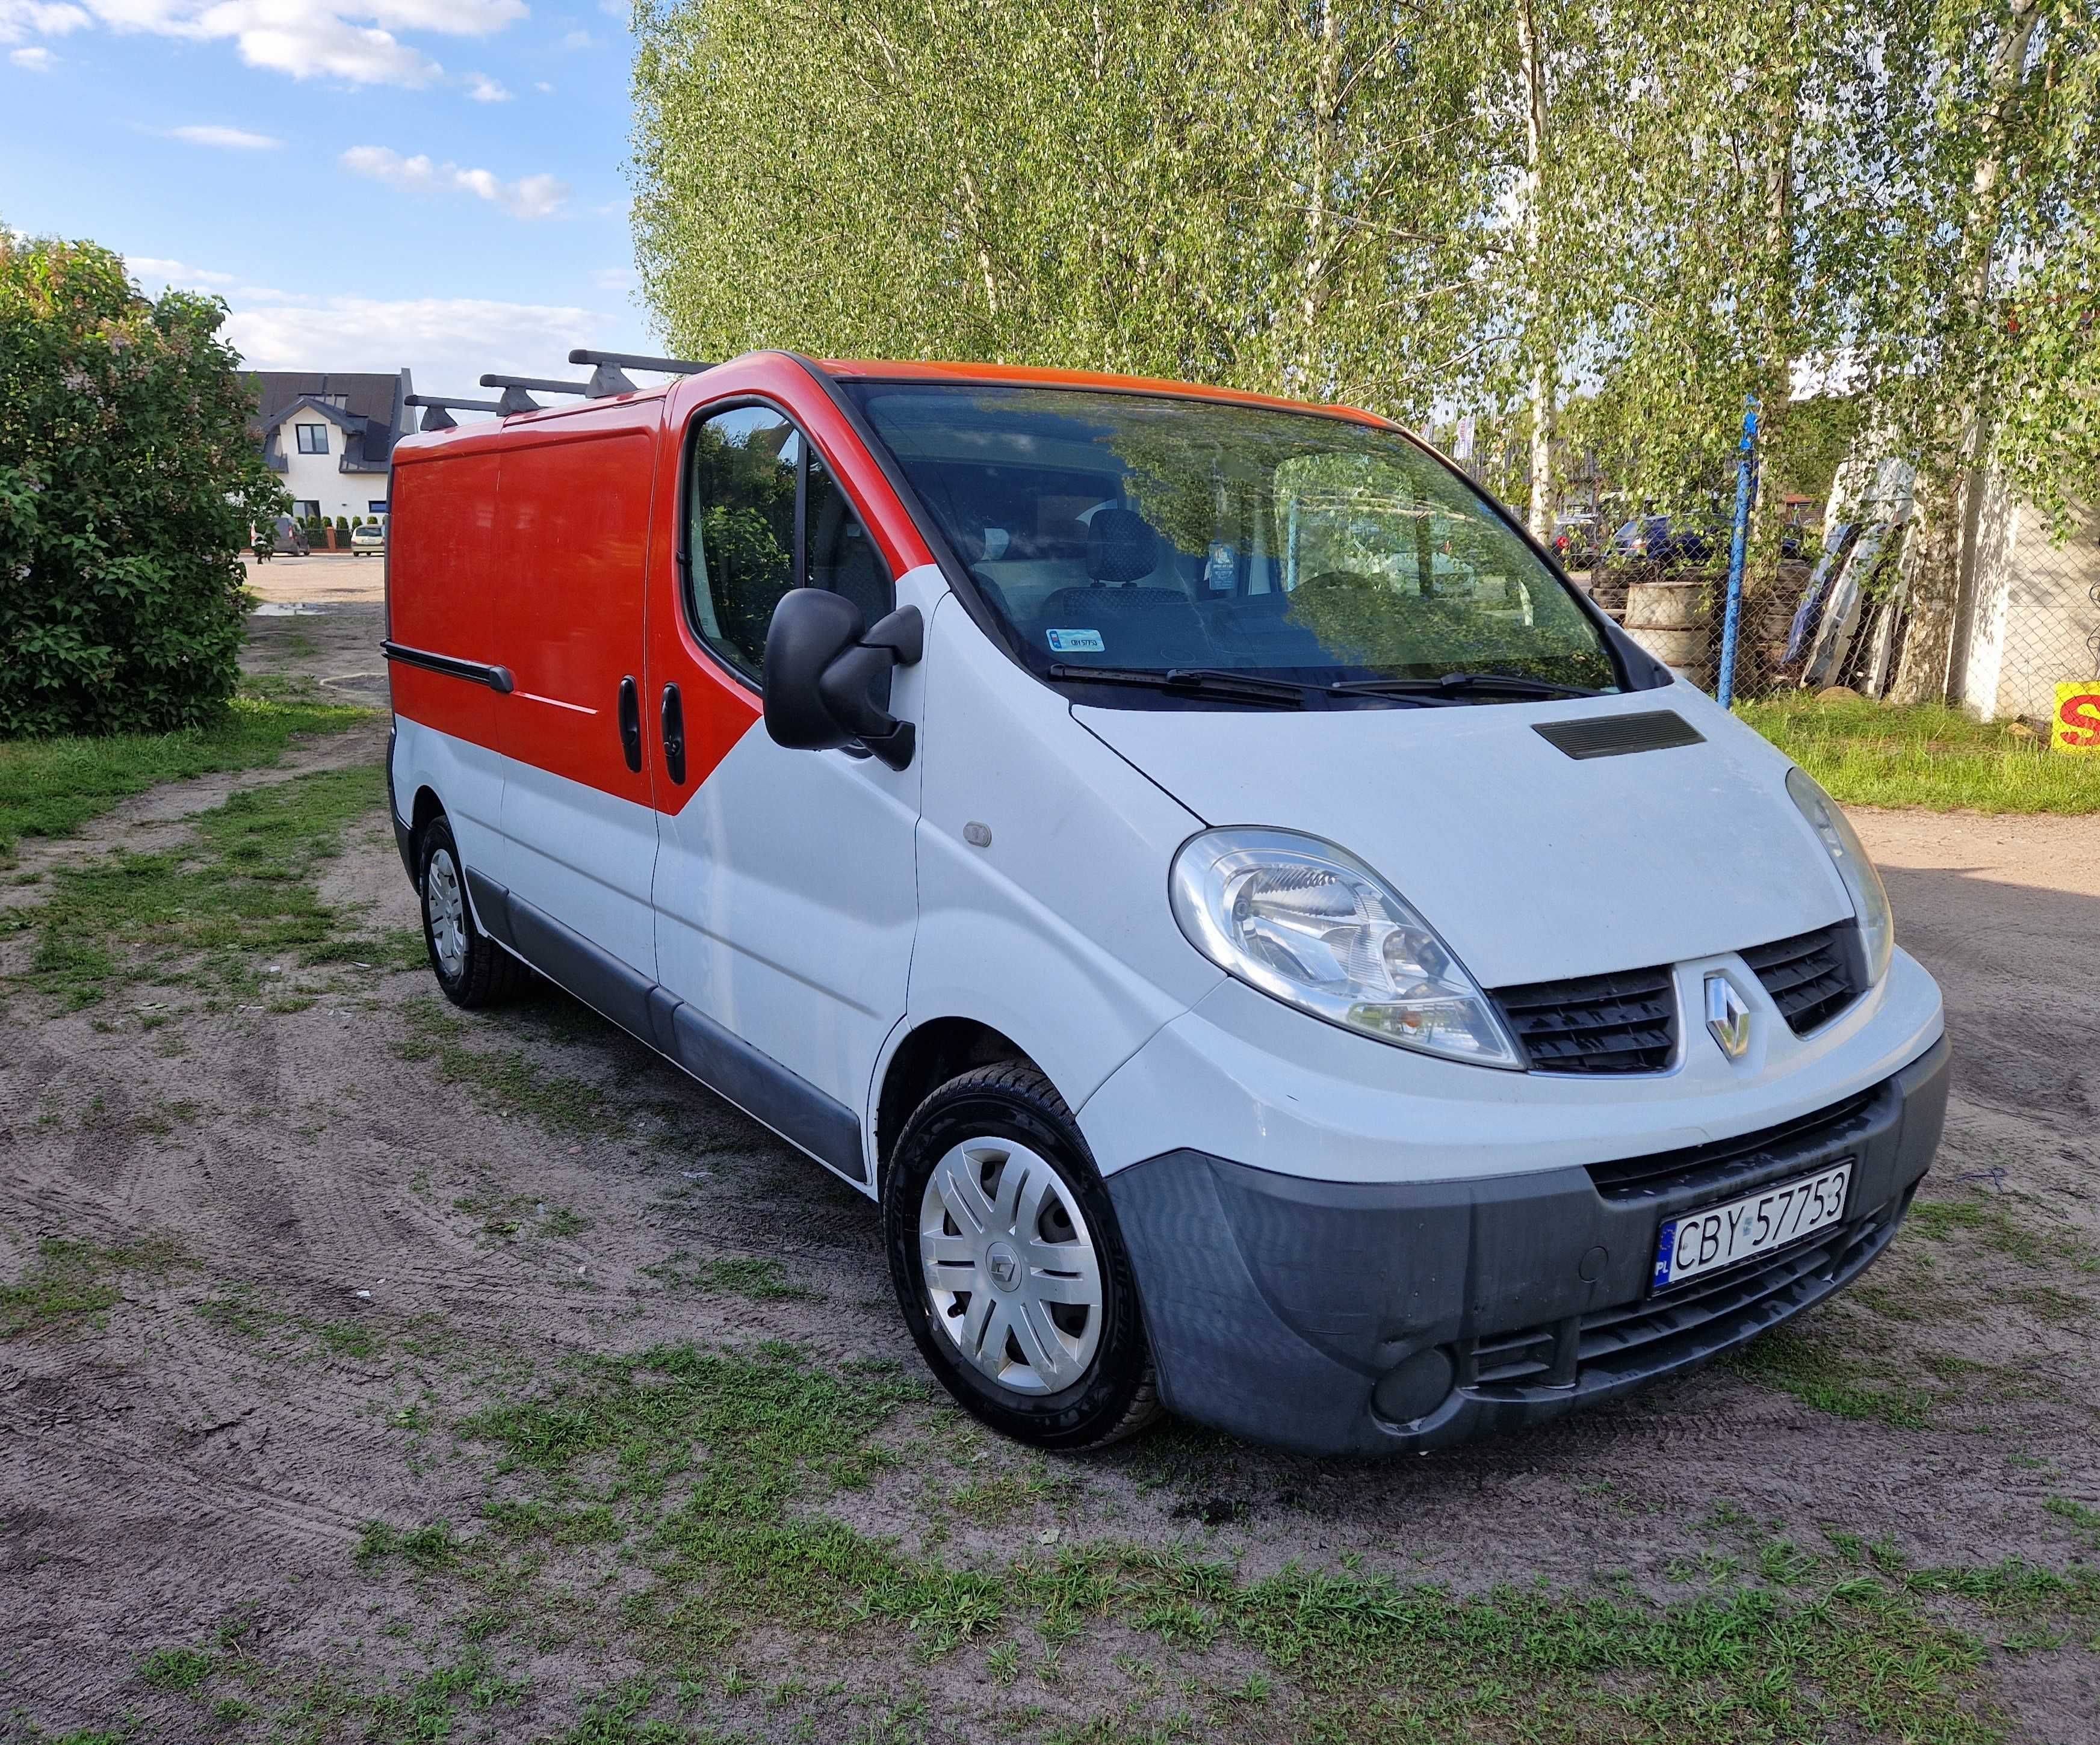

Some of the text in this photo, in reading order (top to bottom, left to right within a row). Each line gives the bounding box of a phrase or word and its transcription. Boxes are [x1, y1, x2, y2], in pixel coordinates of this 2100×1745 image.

[1676, 1173, 1845, 1271] CBY 57753
[1655, 1260, 1668, 1276] PL
